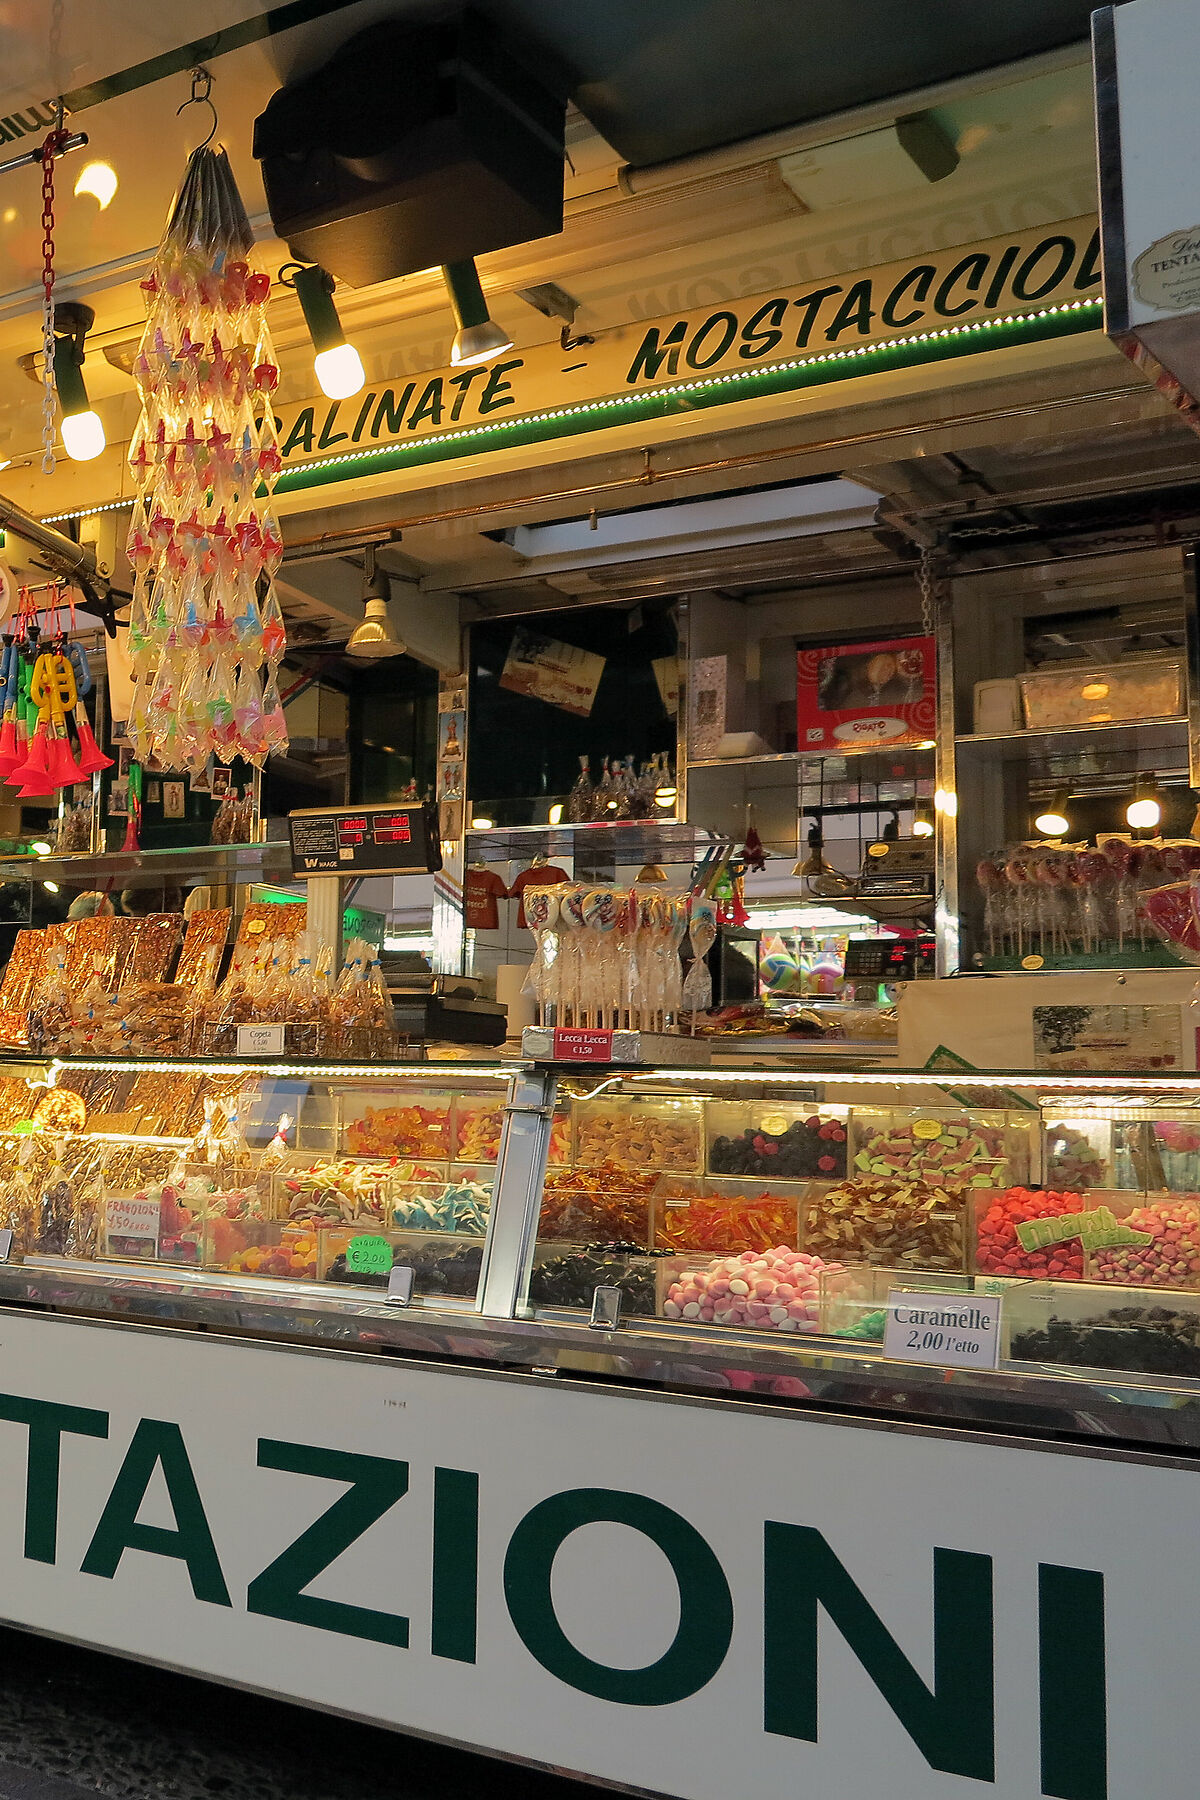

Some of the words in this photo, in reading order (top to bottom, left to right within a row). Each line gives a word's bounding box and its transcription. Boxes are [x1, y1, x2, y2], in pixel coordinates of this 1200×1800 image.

[255, 359, 525, 458] ALINATE
[559, 1033, 583, 1043] Lecca
[583, 1034, 608, 1044] Lecca
[894, 1304, 991, 1331] Caramelle
[906, 1330, 944, 1351] 2,00
[945, 1337, 980, 1354] l'etto
